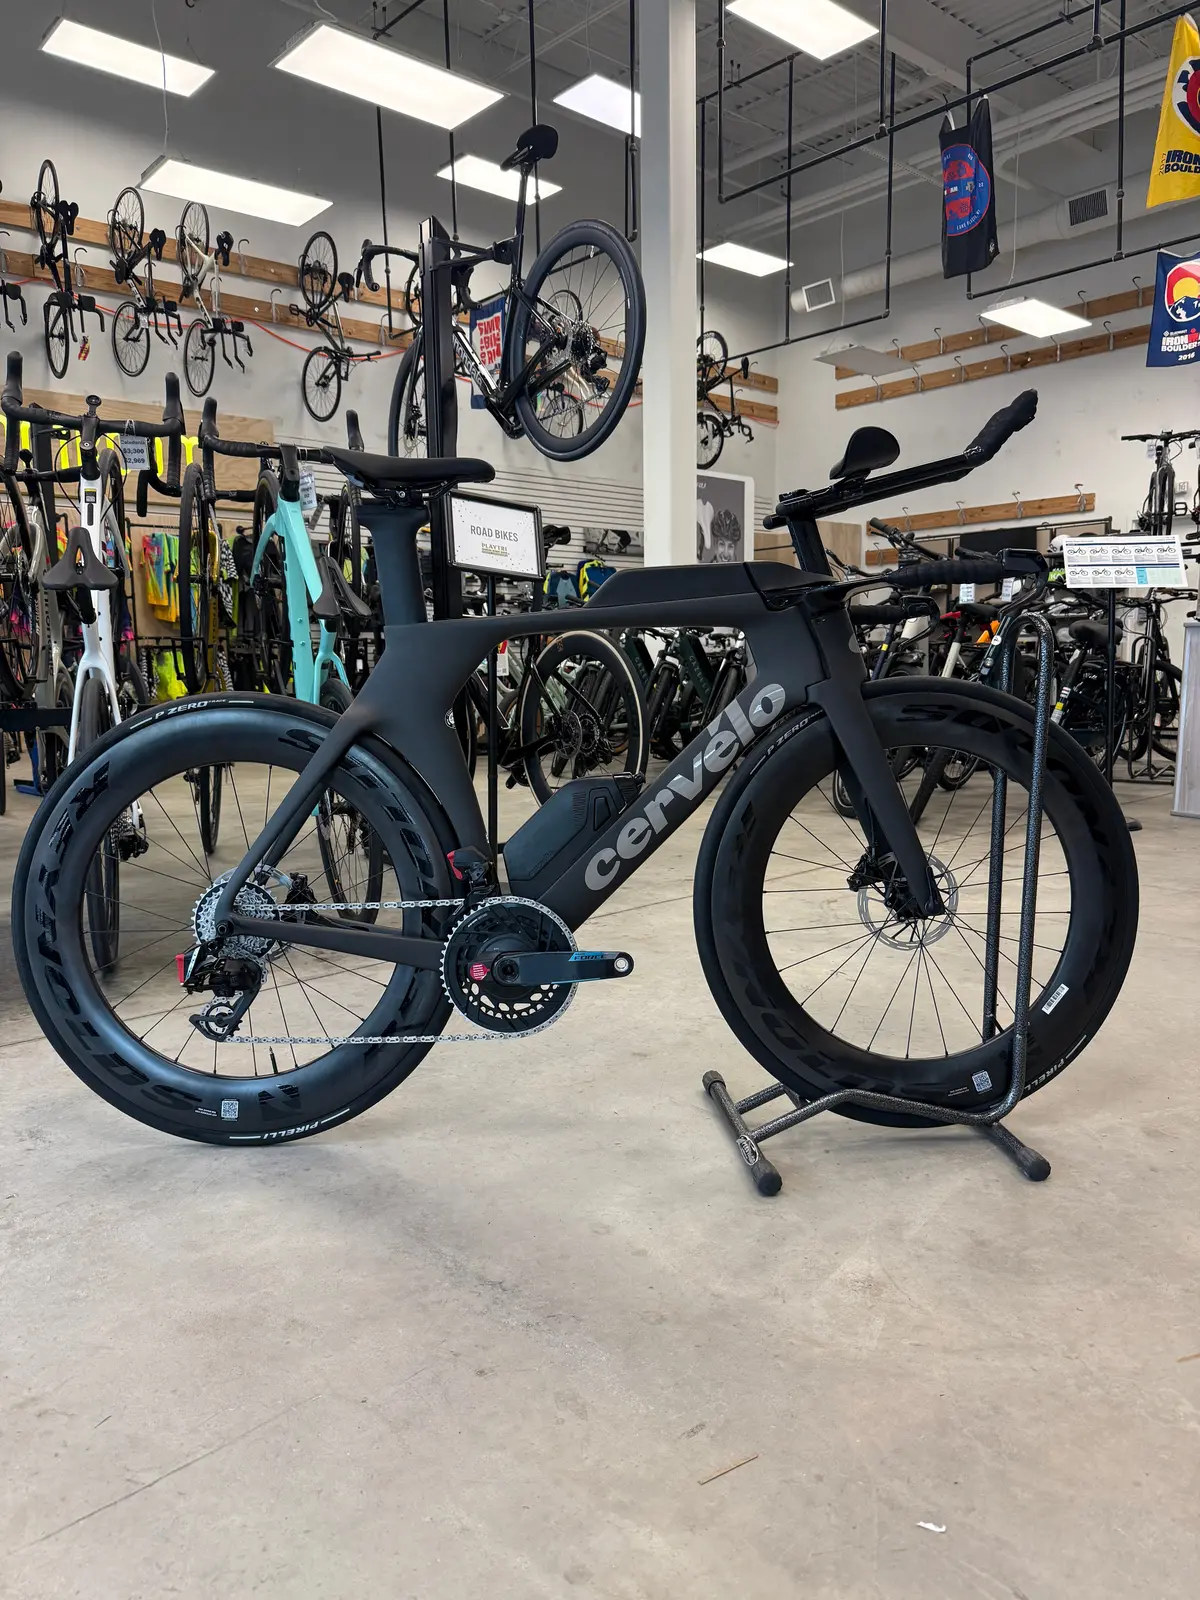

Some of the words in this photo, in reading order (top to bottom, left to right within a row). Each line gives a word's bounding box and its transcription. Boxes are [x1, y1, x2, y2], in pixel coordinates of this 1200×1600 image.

[1161, 341, 1198, 352] BOULDER
[1162, 331, 1200, 346] IRONM
[1178, 351, 1196, 361] 2016
[470, 525, 493, 538] ROAD
[495, 529, 519, 542] BIKES
[481, 542, 508, 551] PLAYTRI
[155, 711, 165, 720] P
[167, 701, 209, 715] ZERO
[767, 744, 775, 756] P
[776, 717, 809, 747] ZERO
[585, 684, 786, 891] cervélo
[1024, 1058, 1065, 1091] PIRELL
[263, 1121, 319, 1140] PIRELLI
